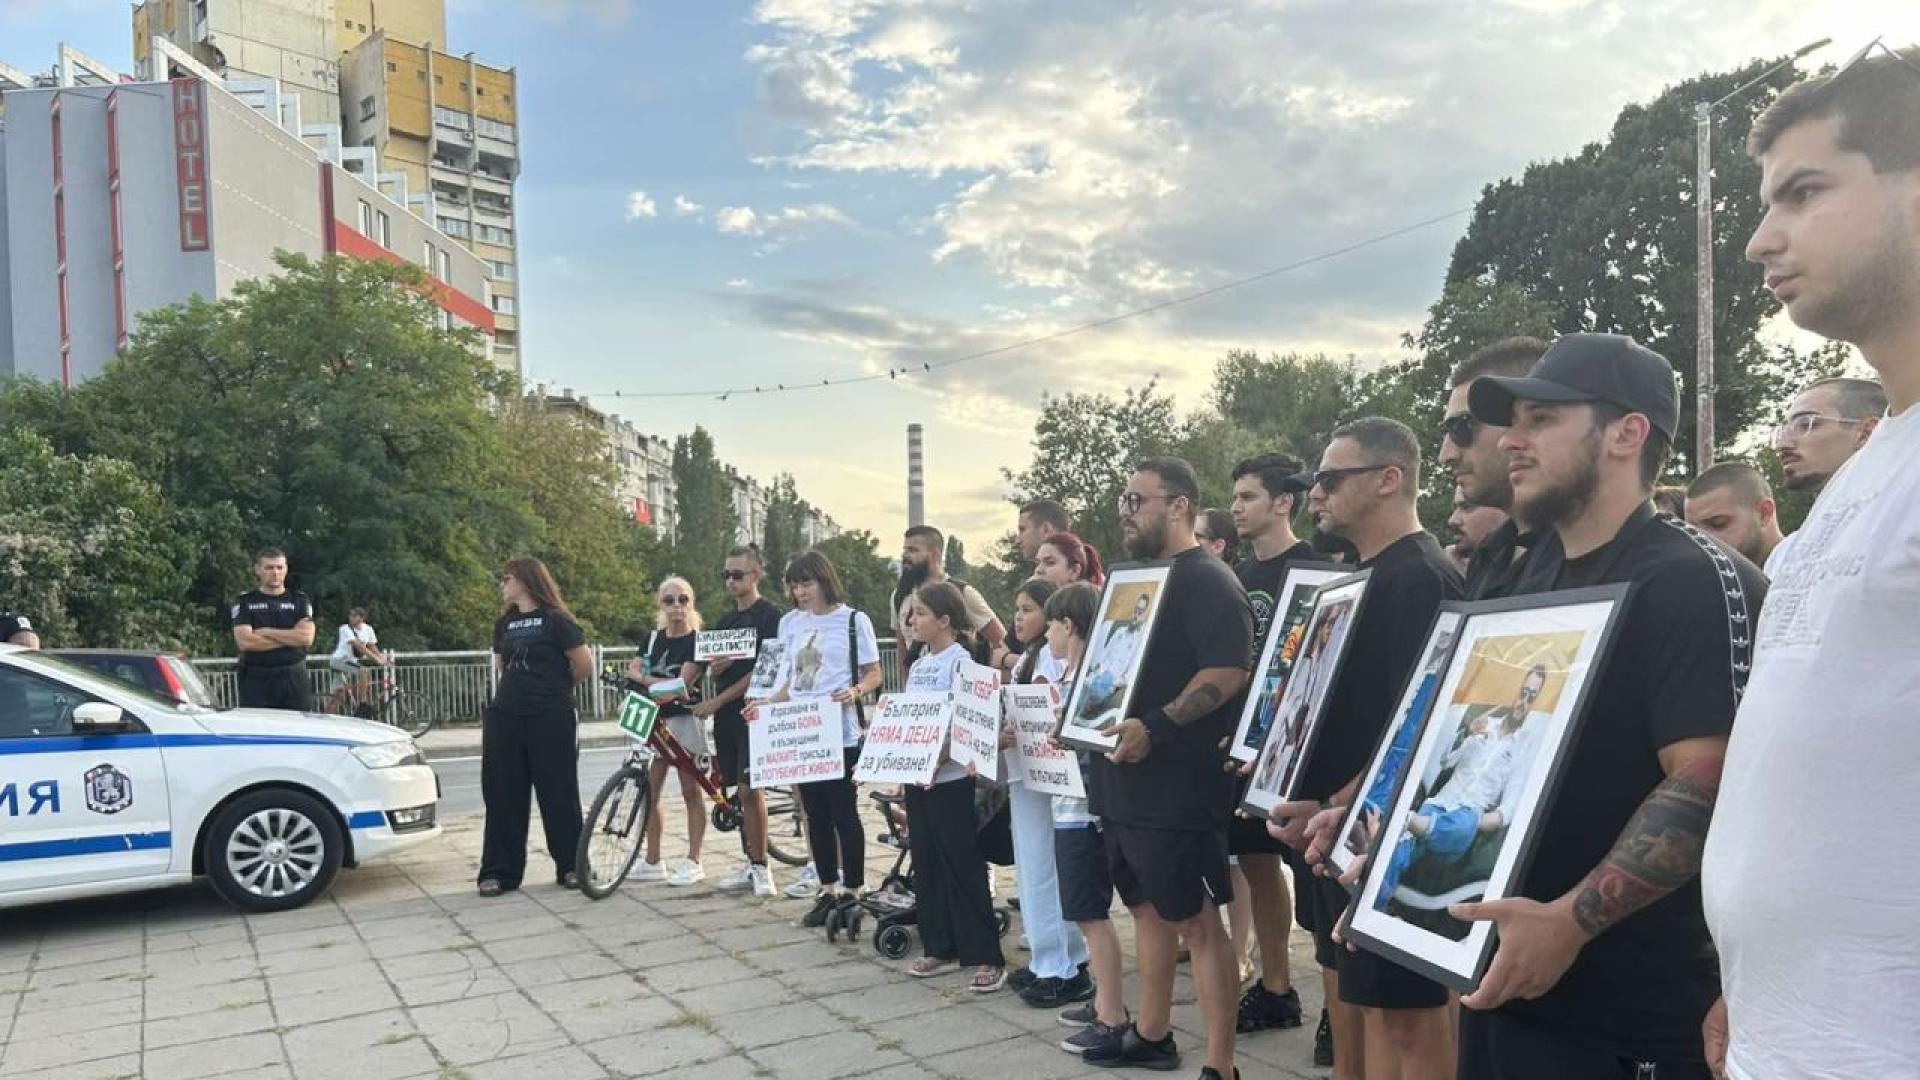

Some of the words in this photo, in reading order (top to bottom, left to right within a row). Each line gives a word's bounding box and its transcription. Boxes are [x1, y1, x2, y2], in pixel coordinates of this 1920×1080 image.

[180, 83, 205, 246] HOTEL
[699, 643, 709, 653] НЕ
[713, 642, 724, 652] СА
[725, 641, 755, 651] ПИСТИ
[627, 702, 649, 732] 11
[883, 700, 941, 720] България
[798, 715, 822, 729] БОЛКА
[869, 725, 903, 745] НЯМА
[902, 725, 941, 747] ДЕЦА
[861, 757, 874, 769] за
[873, 752, 932, 775] убиване!
